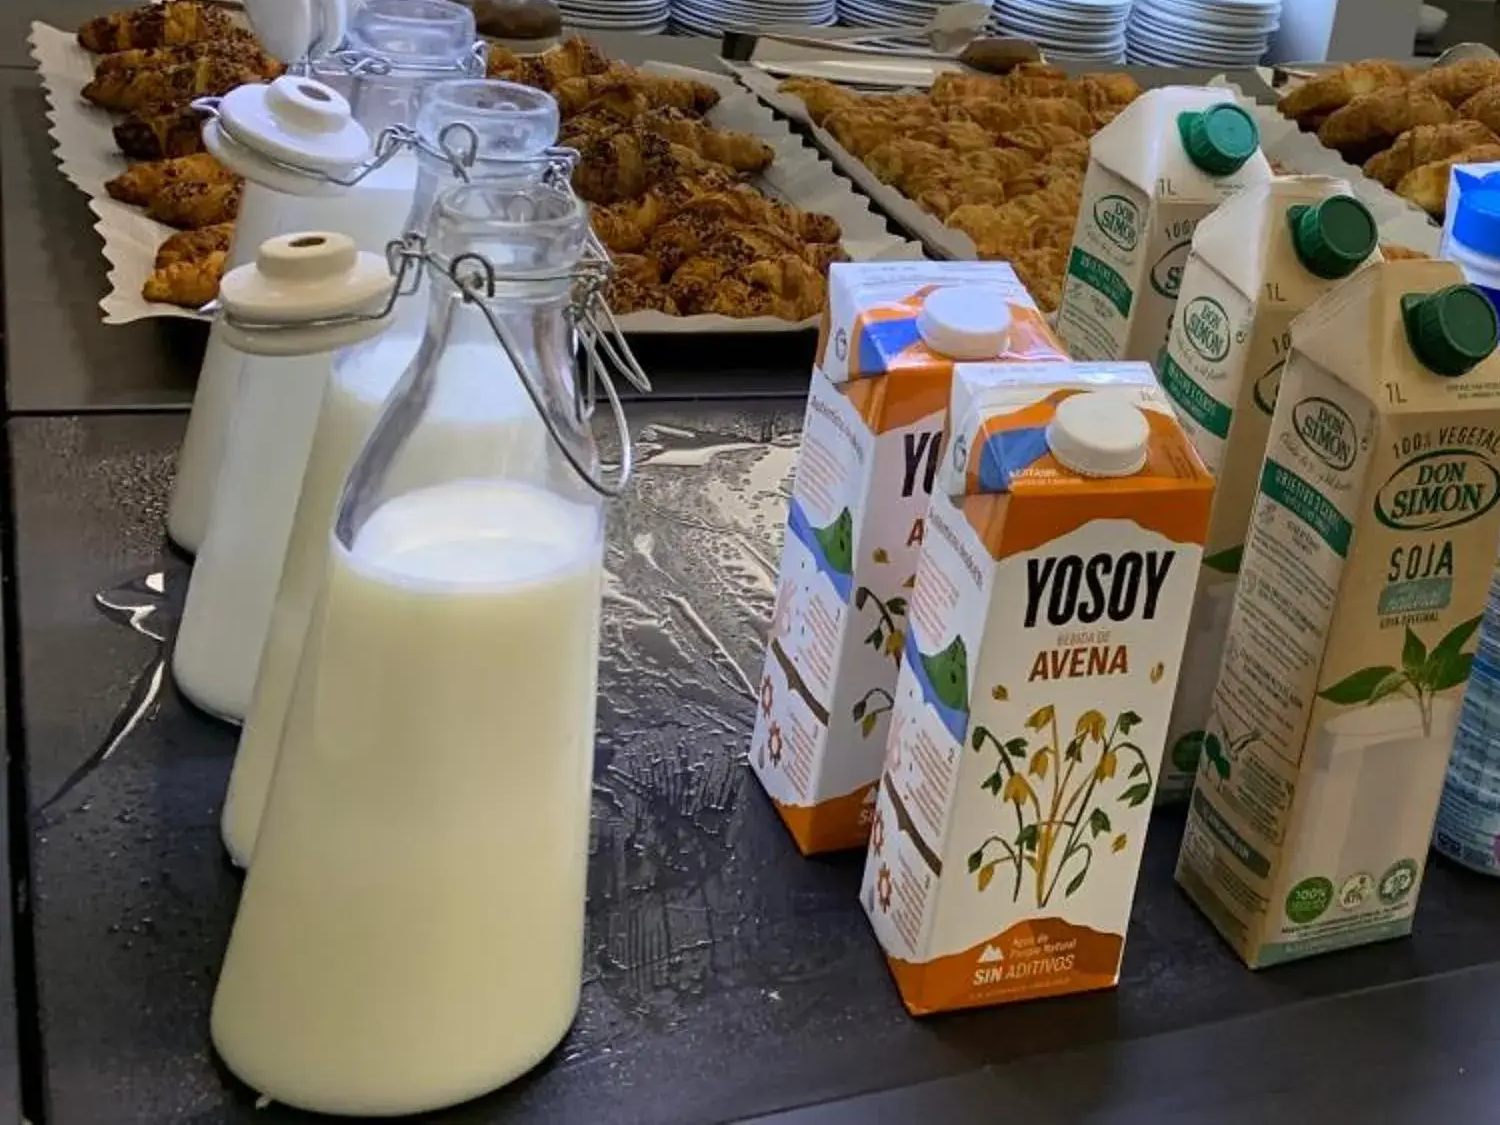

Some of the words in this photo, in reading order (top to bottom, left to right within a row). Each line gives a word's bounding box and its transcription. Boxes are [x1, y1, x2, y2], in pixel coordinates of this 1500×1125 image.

[1265, 282, 1287, 303] 1L
[1385, 382, 1408, 404] 1L
[1316, 404, 1345, 430] DON
[1302, 414, 1351, 463] SIMON
[1416, 462, 1468, 486] DON
[1391, 482, 1486, 520] SIMON
[1388, 540, 1454, 582] SOJA
[1023, 550, 1176, 629] YOSOY
[1028, 644, 1129, 683] AVENA
[973, 966, 1003, 987] SIN
[1004, 953, 1076, 980] ADITIVOS
